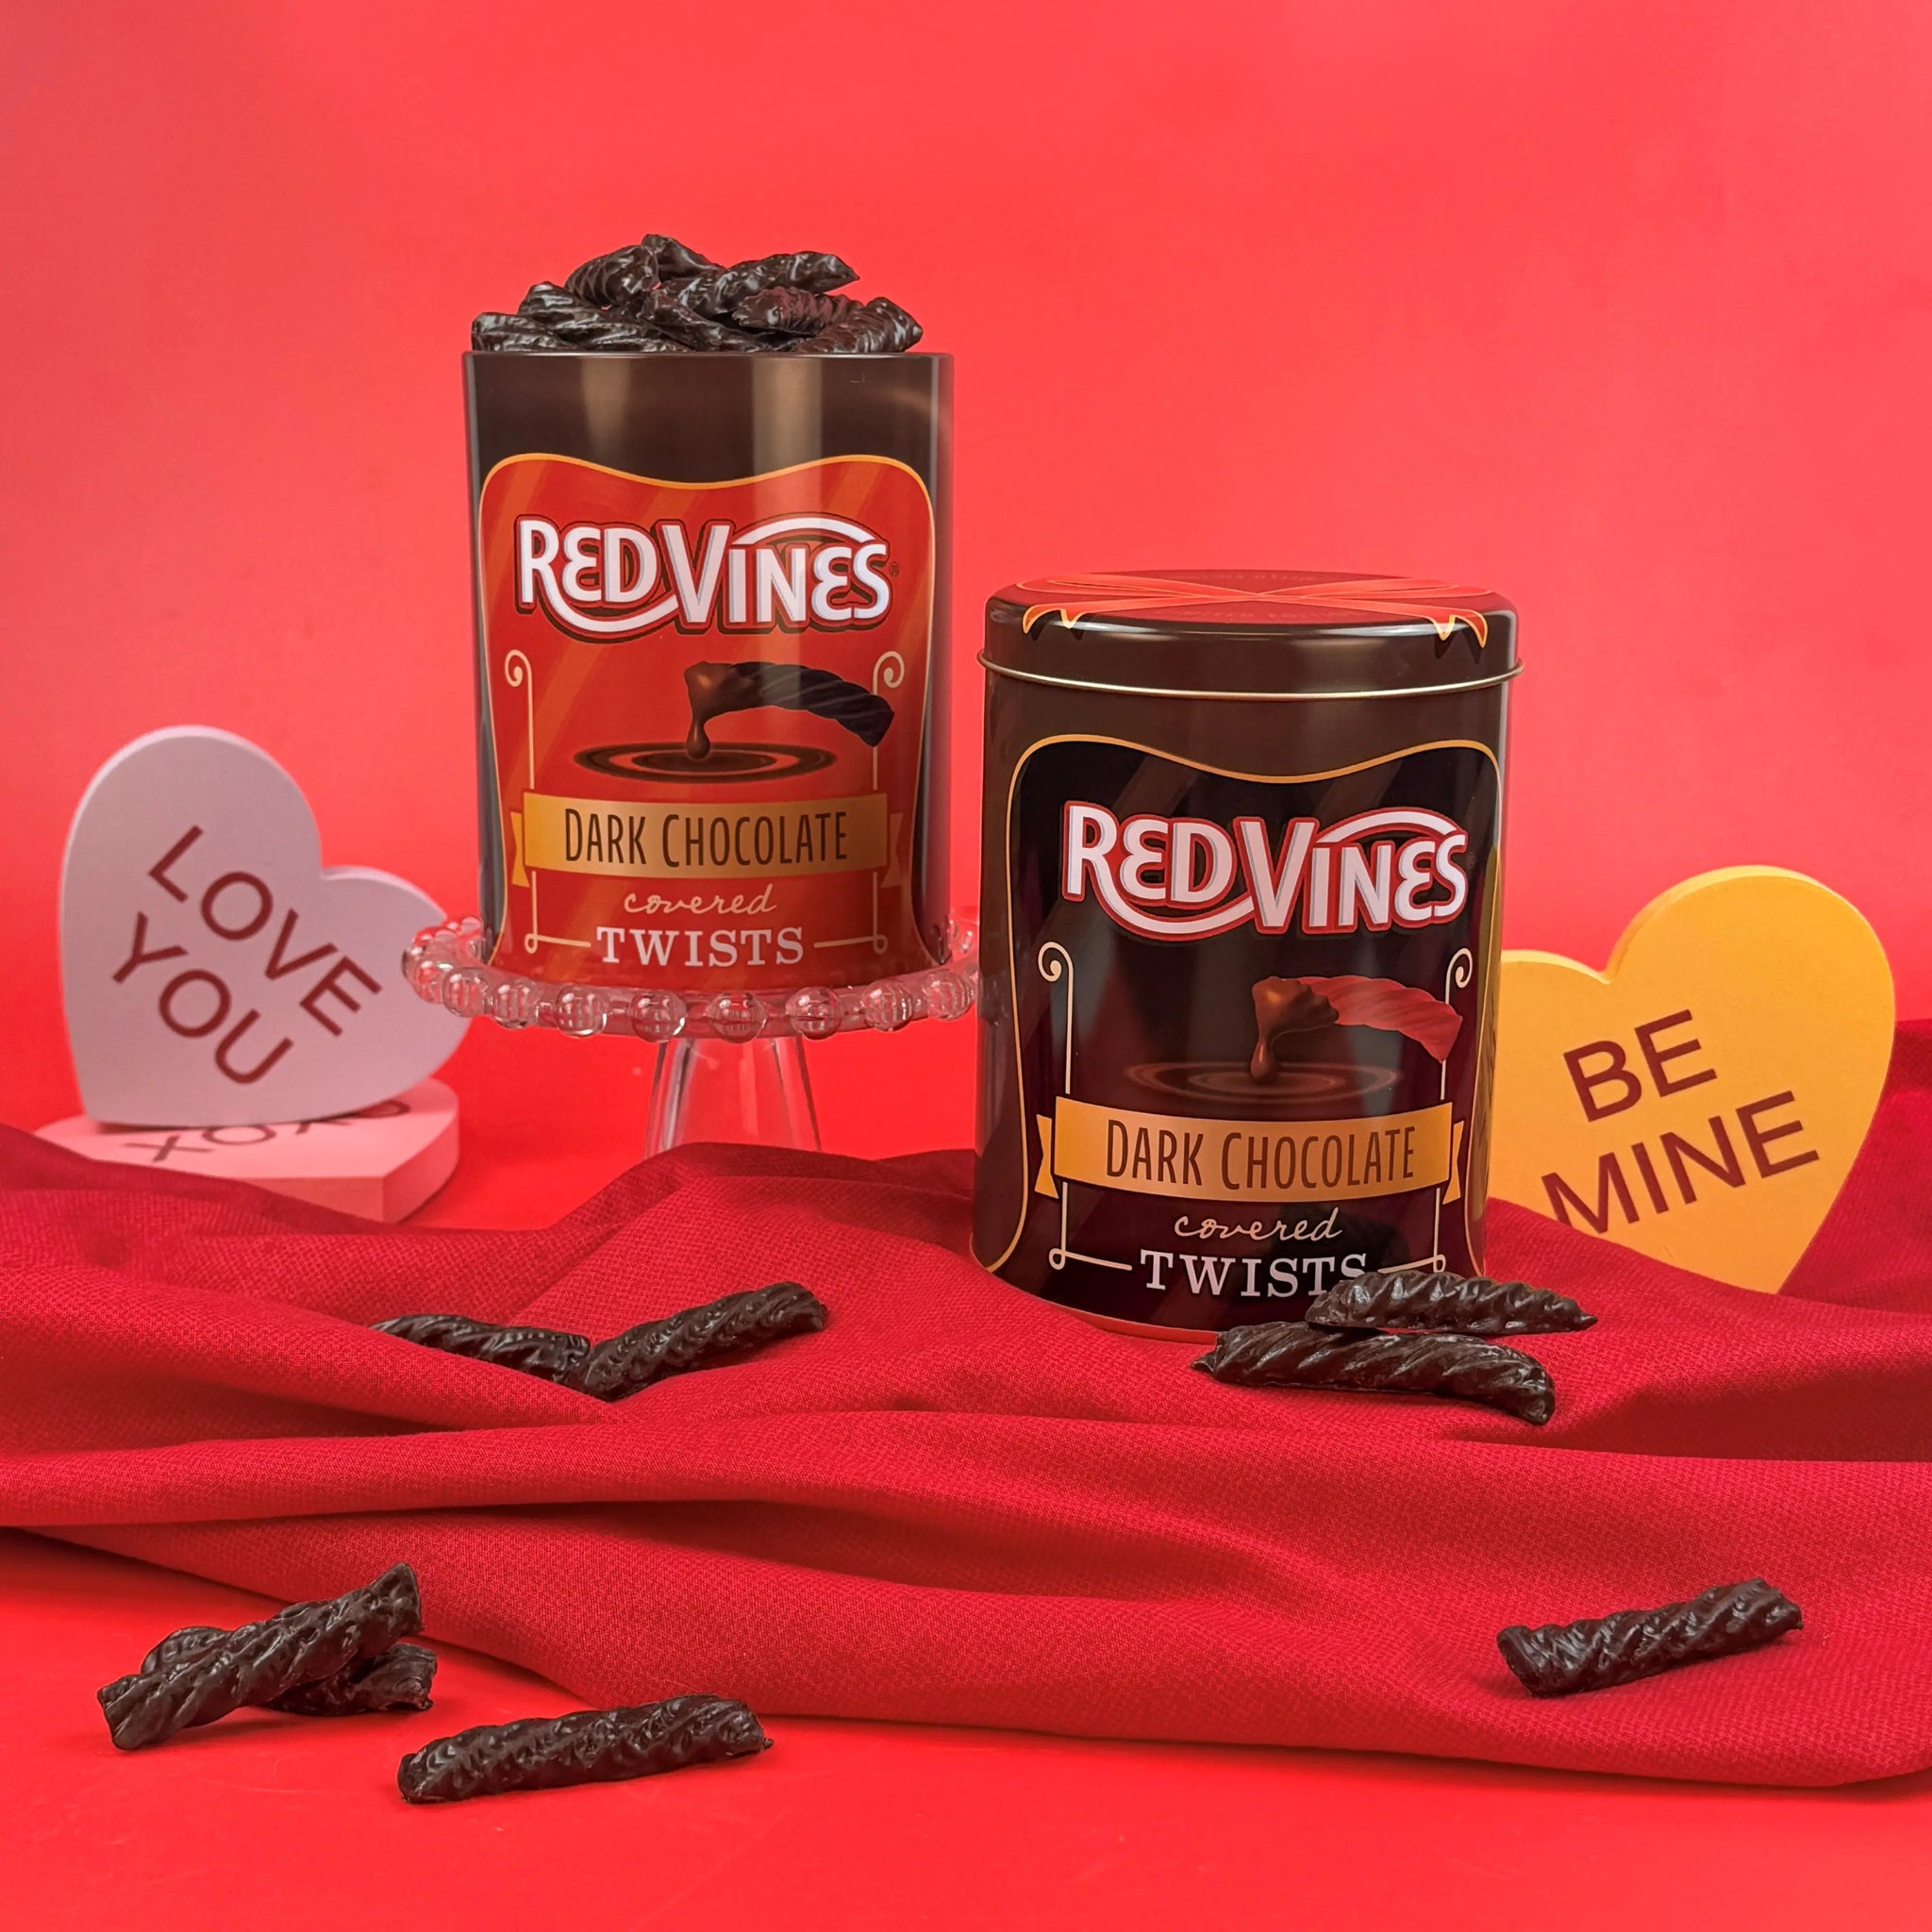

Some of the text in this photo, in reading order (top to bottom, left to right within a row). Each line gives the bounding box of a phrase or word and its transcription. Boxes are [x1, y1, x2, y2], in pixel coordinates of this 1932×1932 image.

[565, 808, 848, 867] DARK CHOCOLATE
[148, 824, 383, 1038] LOVE
[624, 883, 777, 915] covered
[596, 926, 806, 967] TWISTS
[111, 911, 295, 1085] YOU
[1562, 1008, 1718, 1124] BE
[1106, 1119, 1416, 1191] DARK CHOCOLATE
[1541, 1091, 1821, 1235] MINE
[1174, 1207, 1343, 1241] covered
